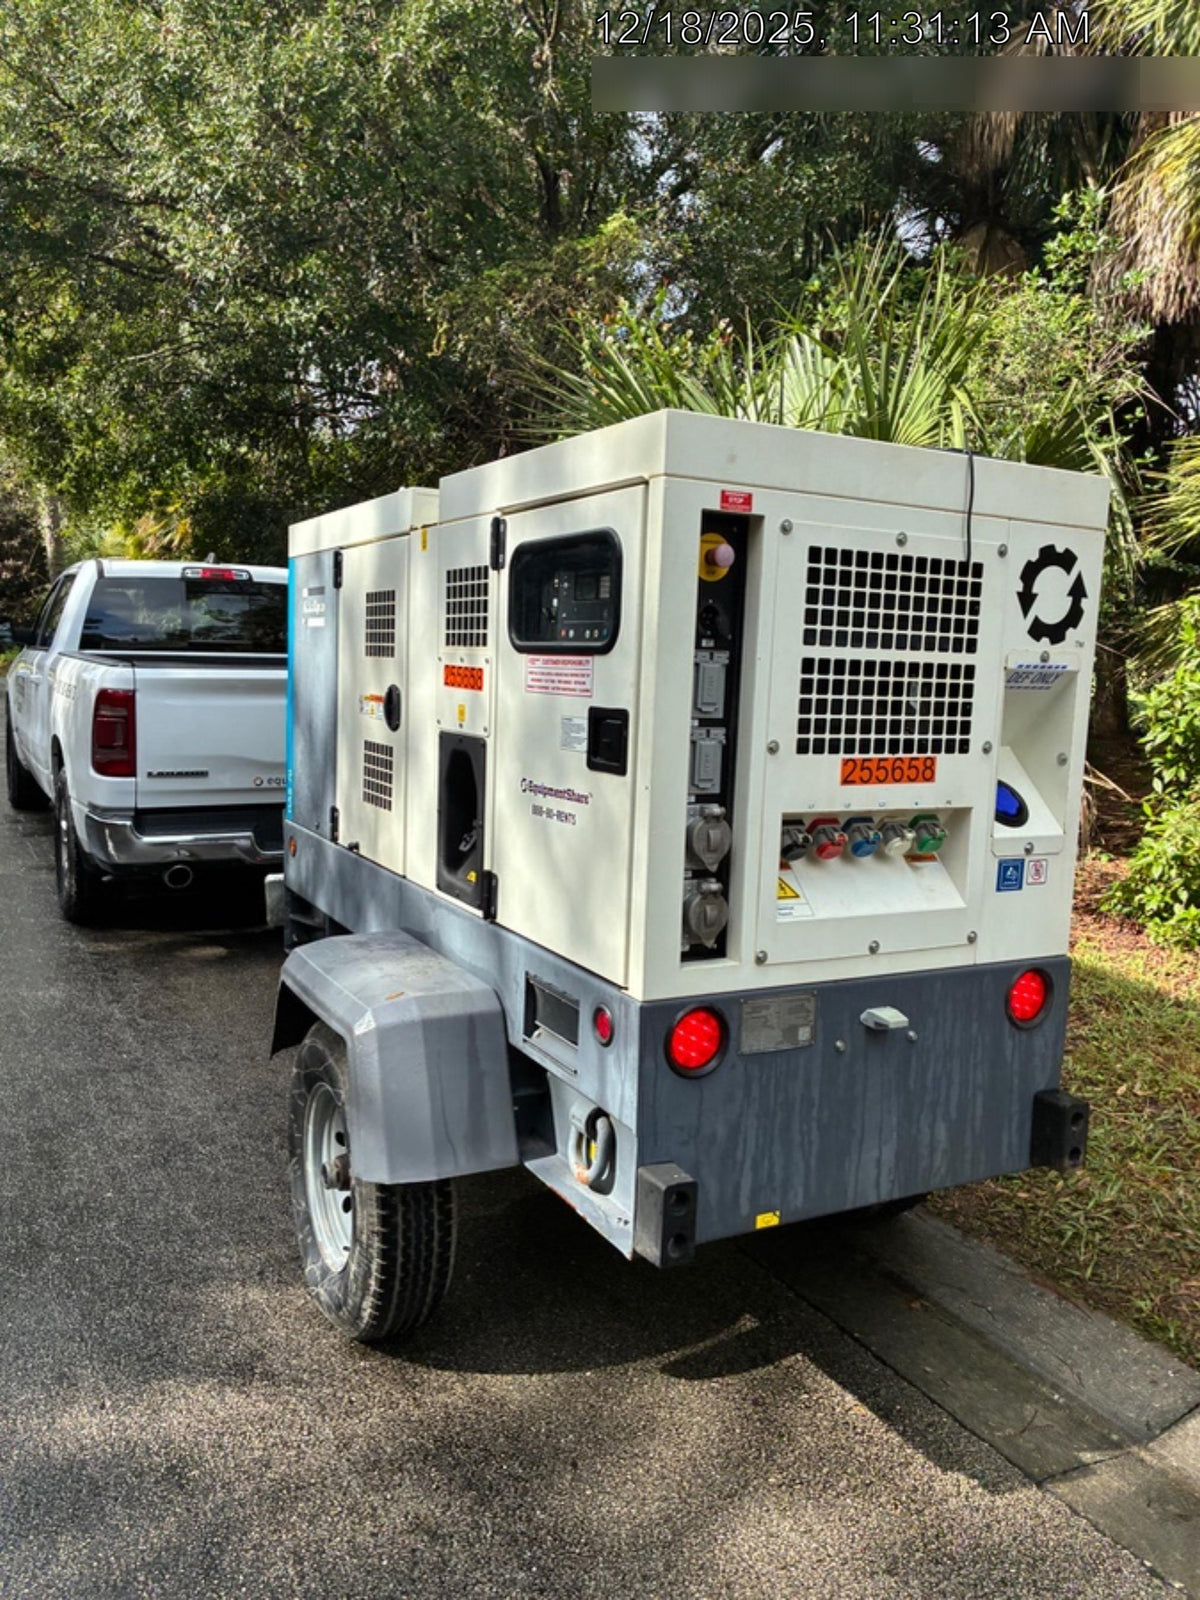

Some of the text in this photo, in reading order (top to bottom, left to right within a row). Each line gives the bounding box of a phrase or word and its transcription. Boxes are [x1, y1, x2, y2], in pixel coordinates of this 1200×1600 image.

[1006, 671, 1064, 684] DEF ONLY
[841, 756, 936, 784] 255658
